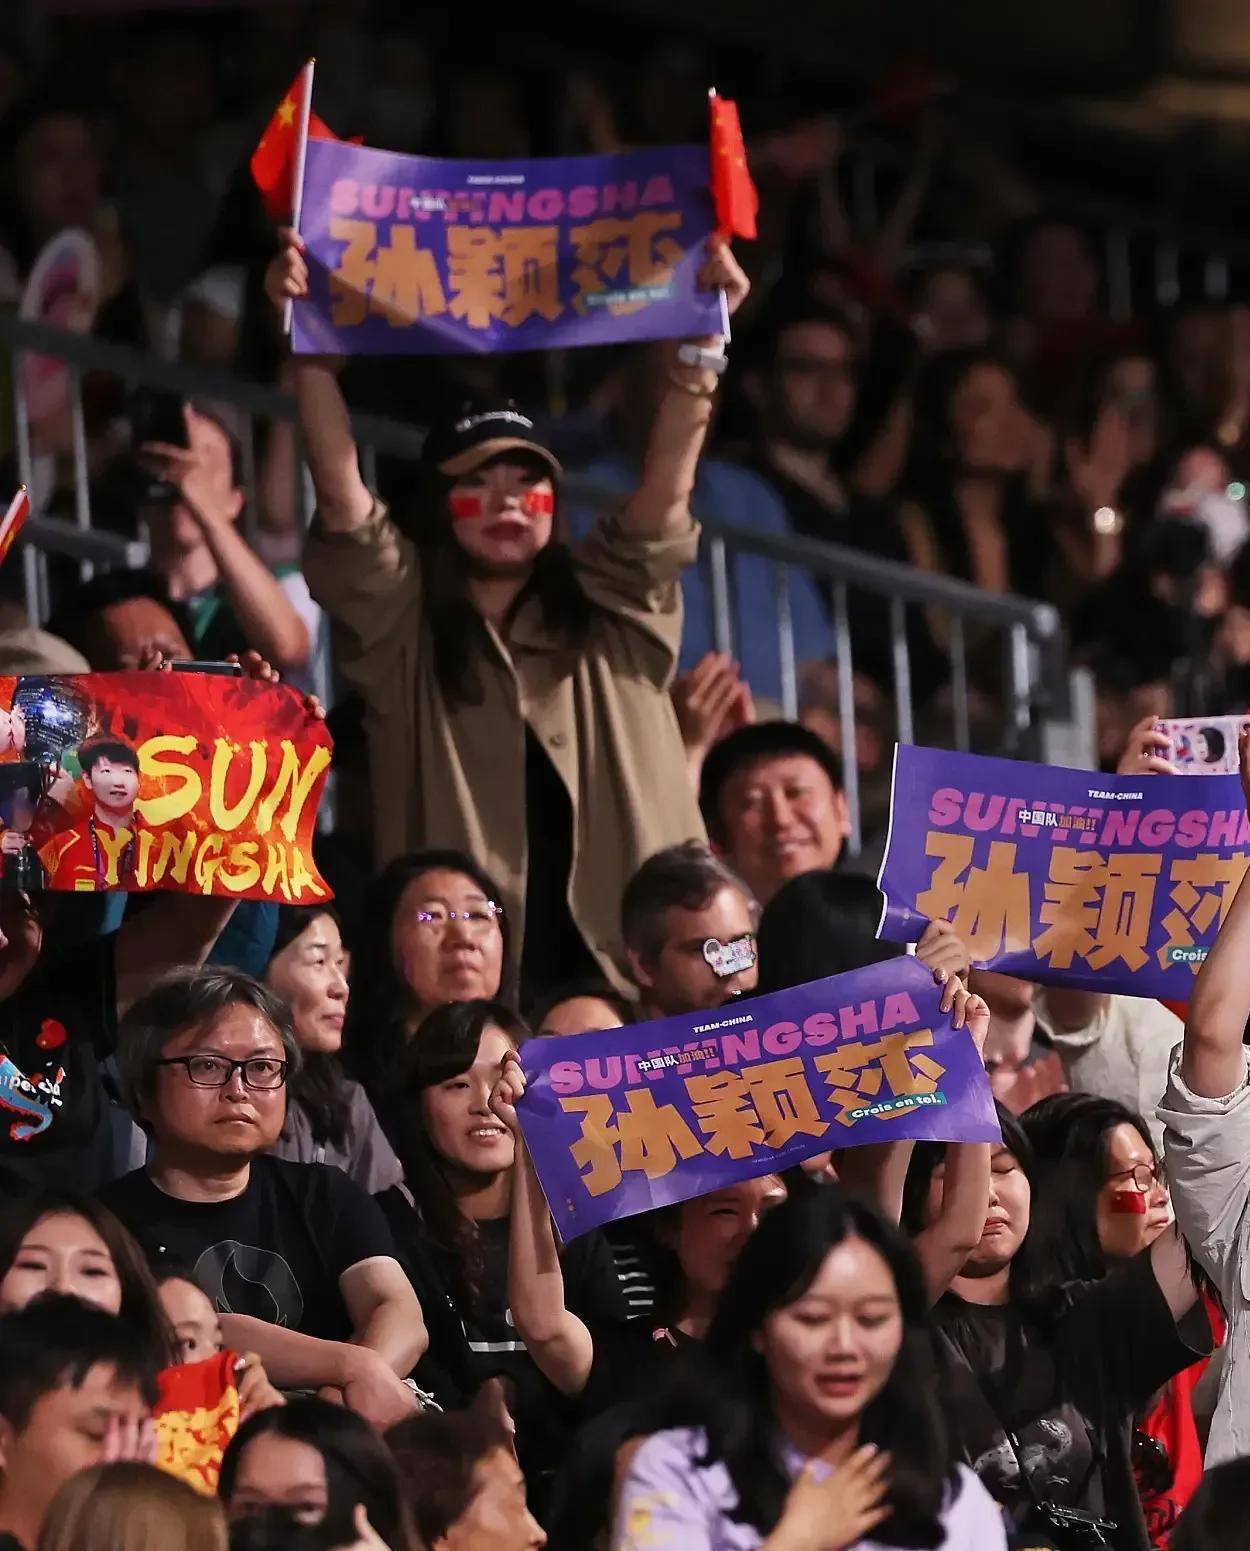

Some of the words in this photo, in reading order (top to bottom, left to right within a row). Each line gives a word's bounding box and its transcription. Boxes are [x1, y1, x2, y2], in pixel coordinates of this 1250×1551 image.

[329, 210, 684, 329] 孙颖莎
[133, 735, 332, 842] SUN
[98, 829, 326, 900] YINGSHA
[549, 991, 921, 1095] SUNYINGSHA
[693, 1015, 754, 1034] TEAM-CHINA
[559, 1028, 946, 1198] 孙颖莎
[851, 1104, 893, 1119] Crois
